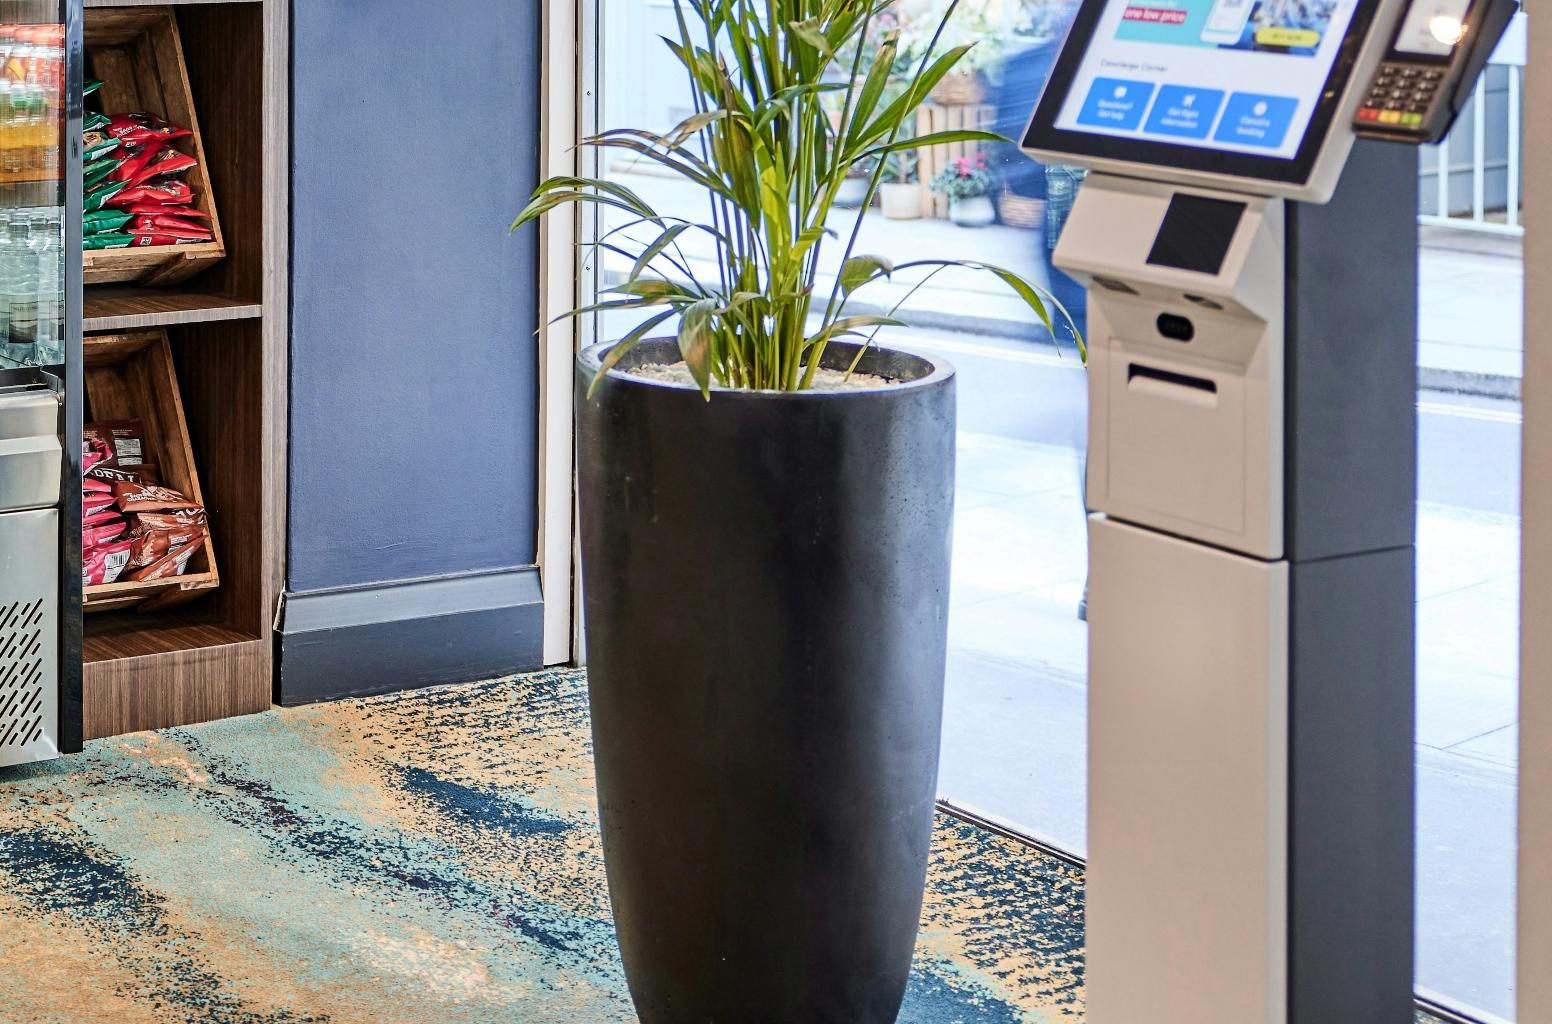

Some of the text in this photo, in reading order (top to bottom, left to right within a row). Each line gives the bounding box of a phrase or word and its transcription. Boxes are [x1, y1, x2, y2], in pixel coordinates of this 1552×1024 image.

[1125, 8, 1186, 23] one low price
